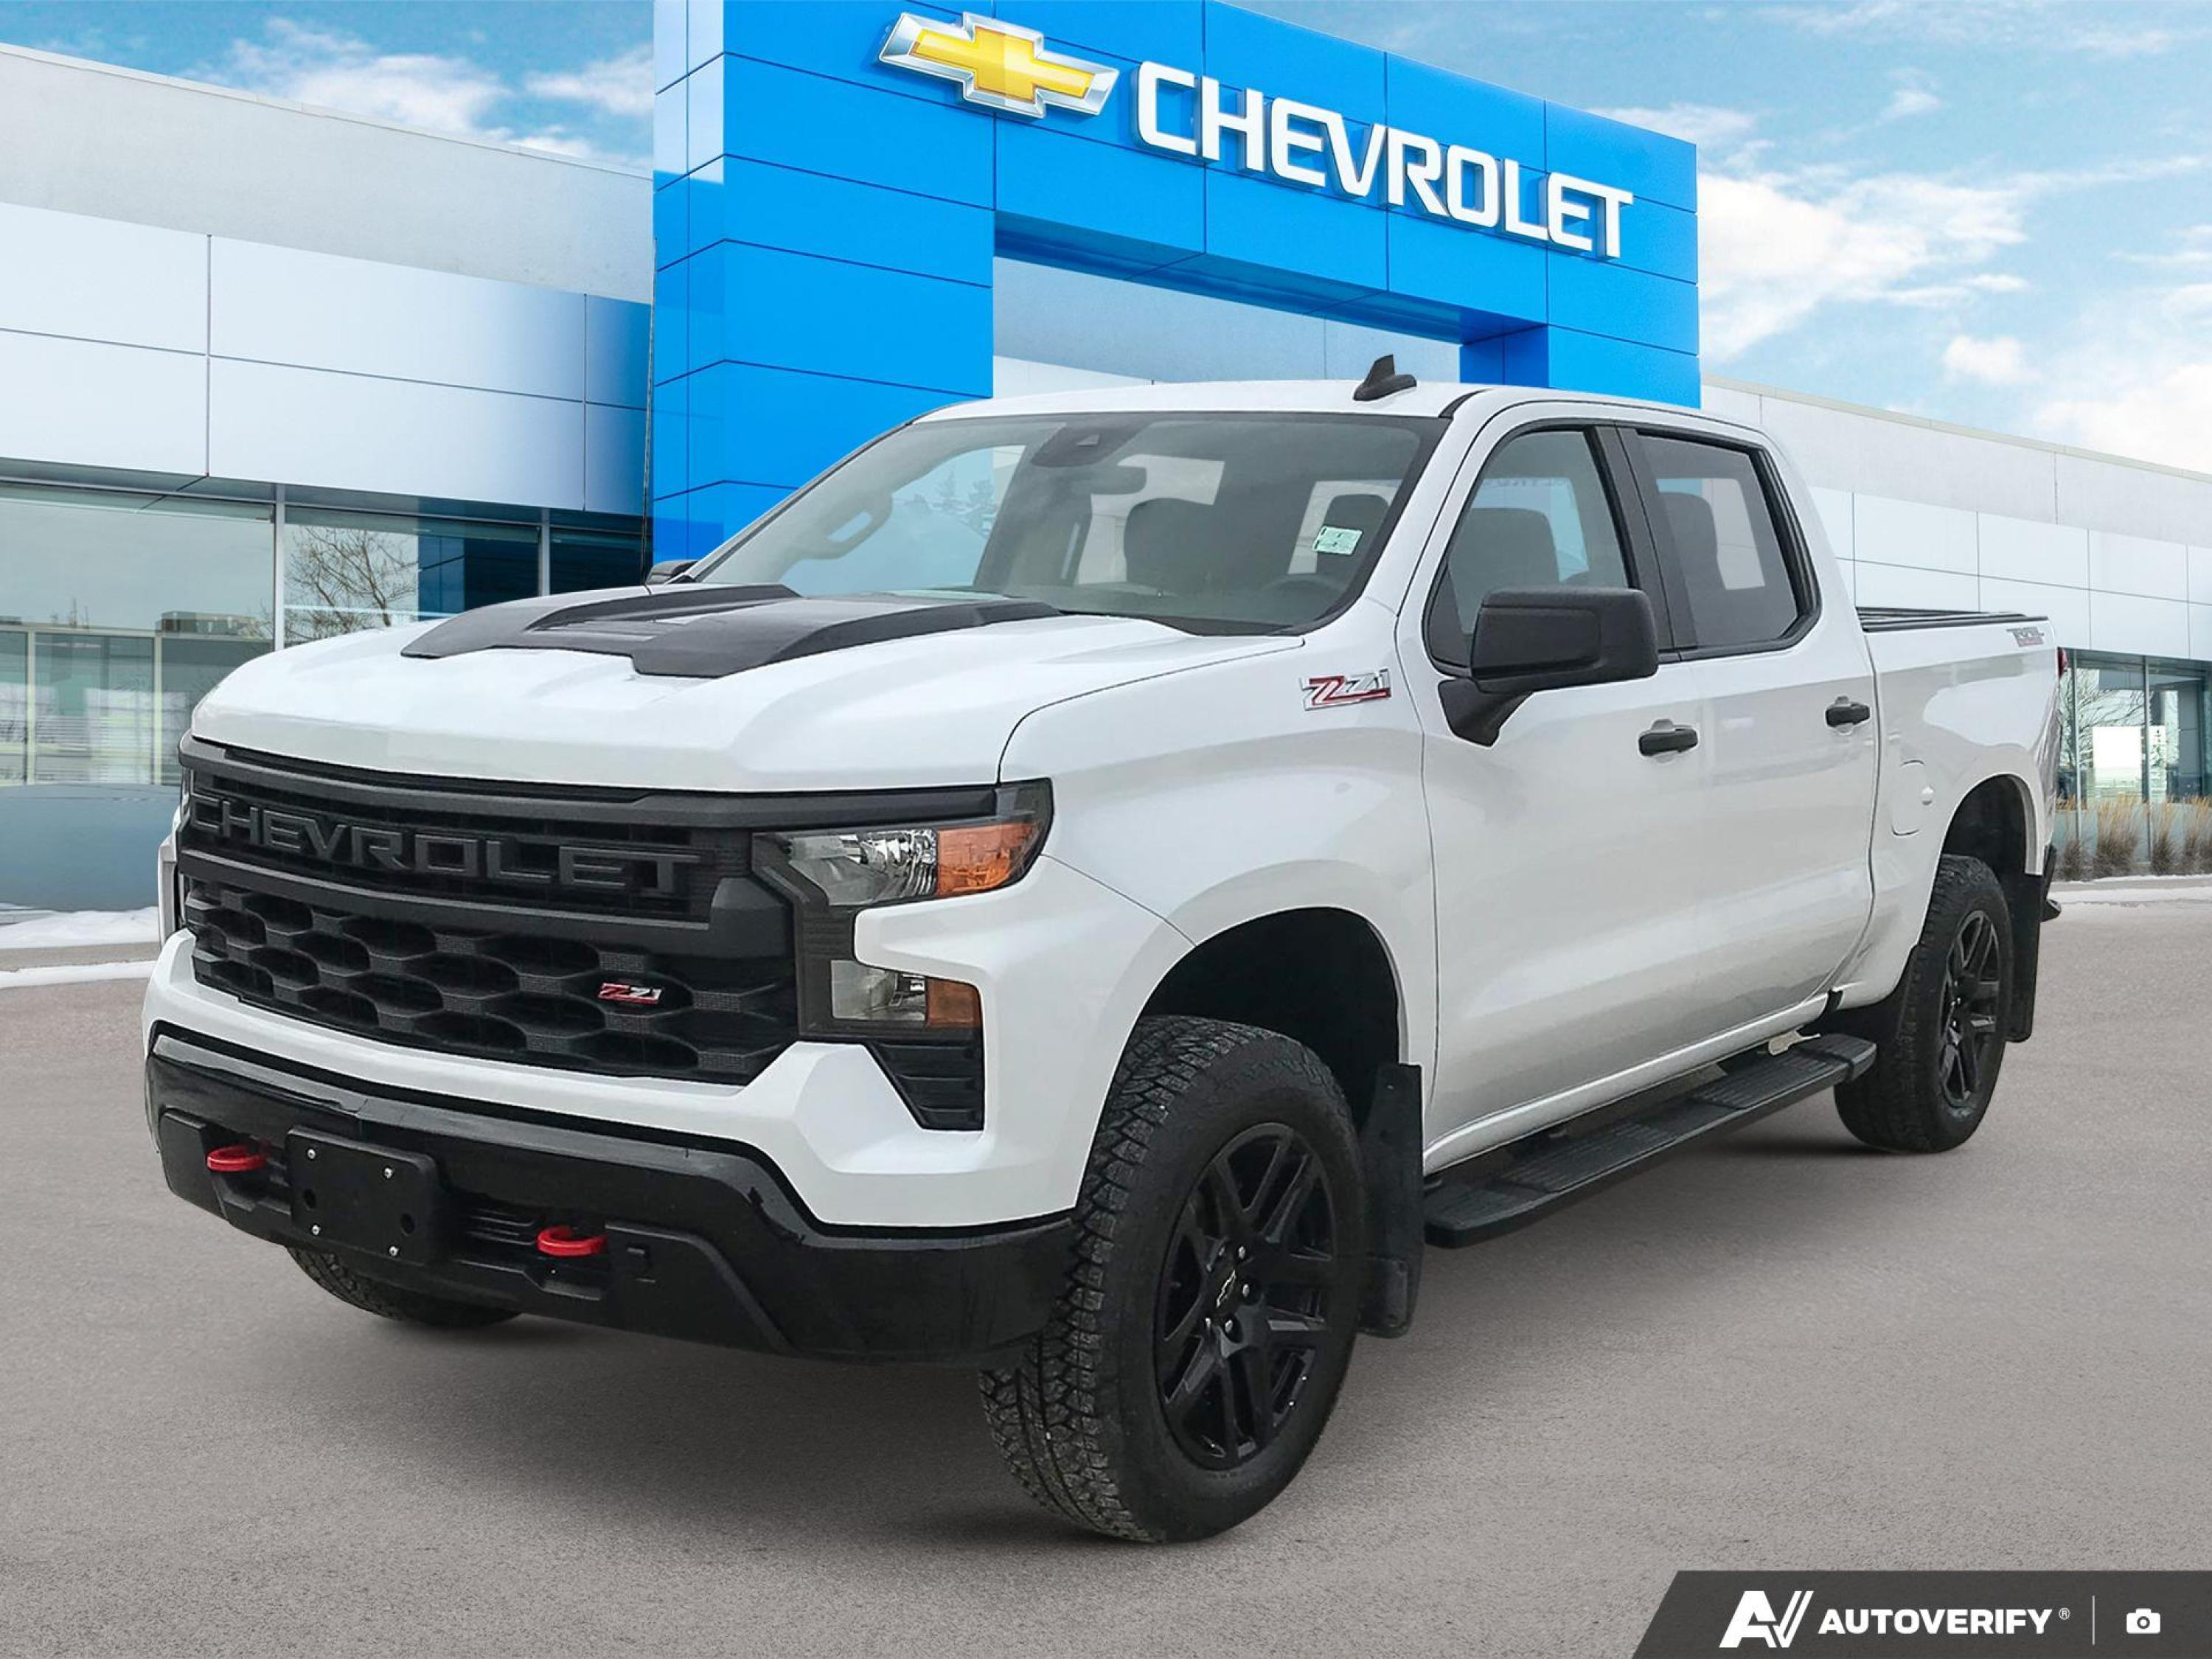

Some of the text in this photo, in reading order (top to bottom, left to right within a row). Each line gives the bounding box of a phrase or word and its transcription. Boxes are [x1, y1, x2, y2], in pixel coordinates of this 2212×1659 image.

[1133, 62, 1635, 260] CHEVROLET
[1300, 668, 1391, 710] Z71
[190, 790, 701, 894] CHEVROLET
[599, 983, 662, 1004] Z71
